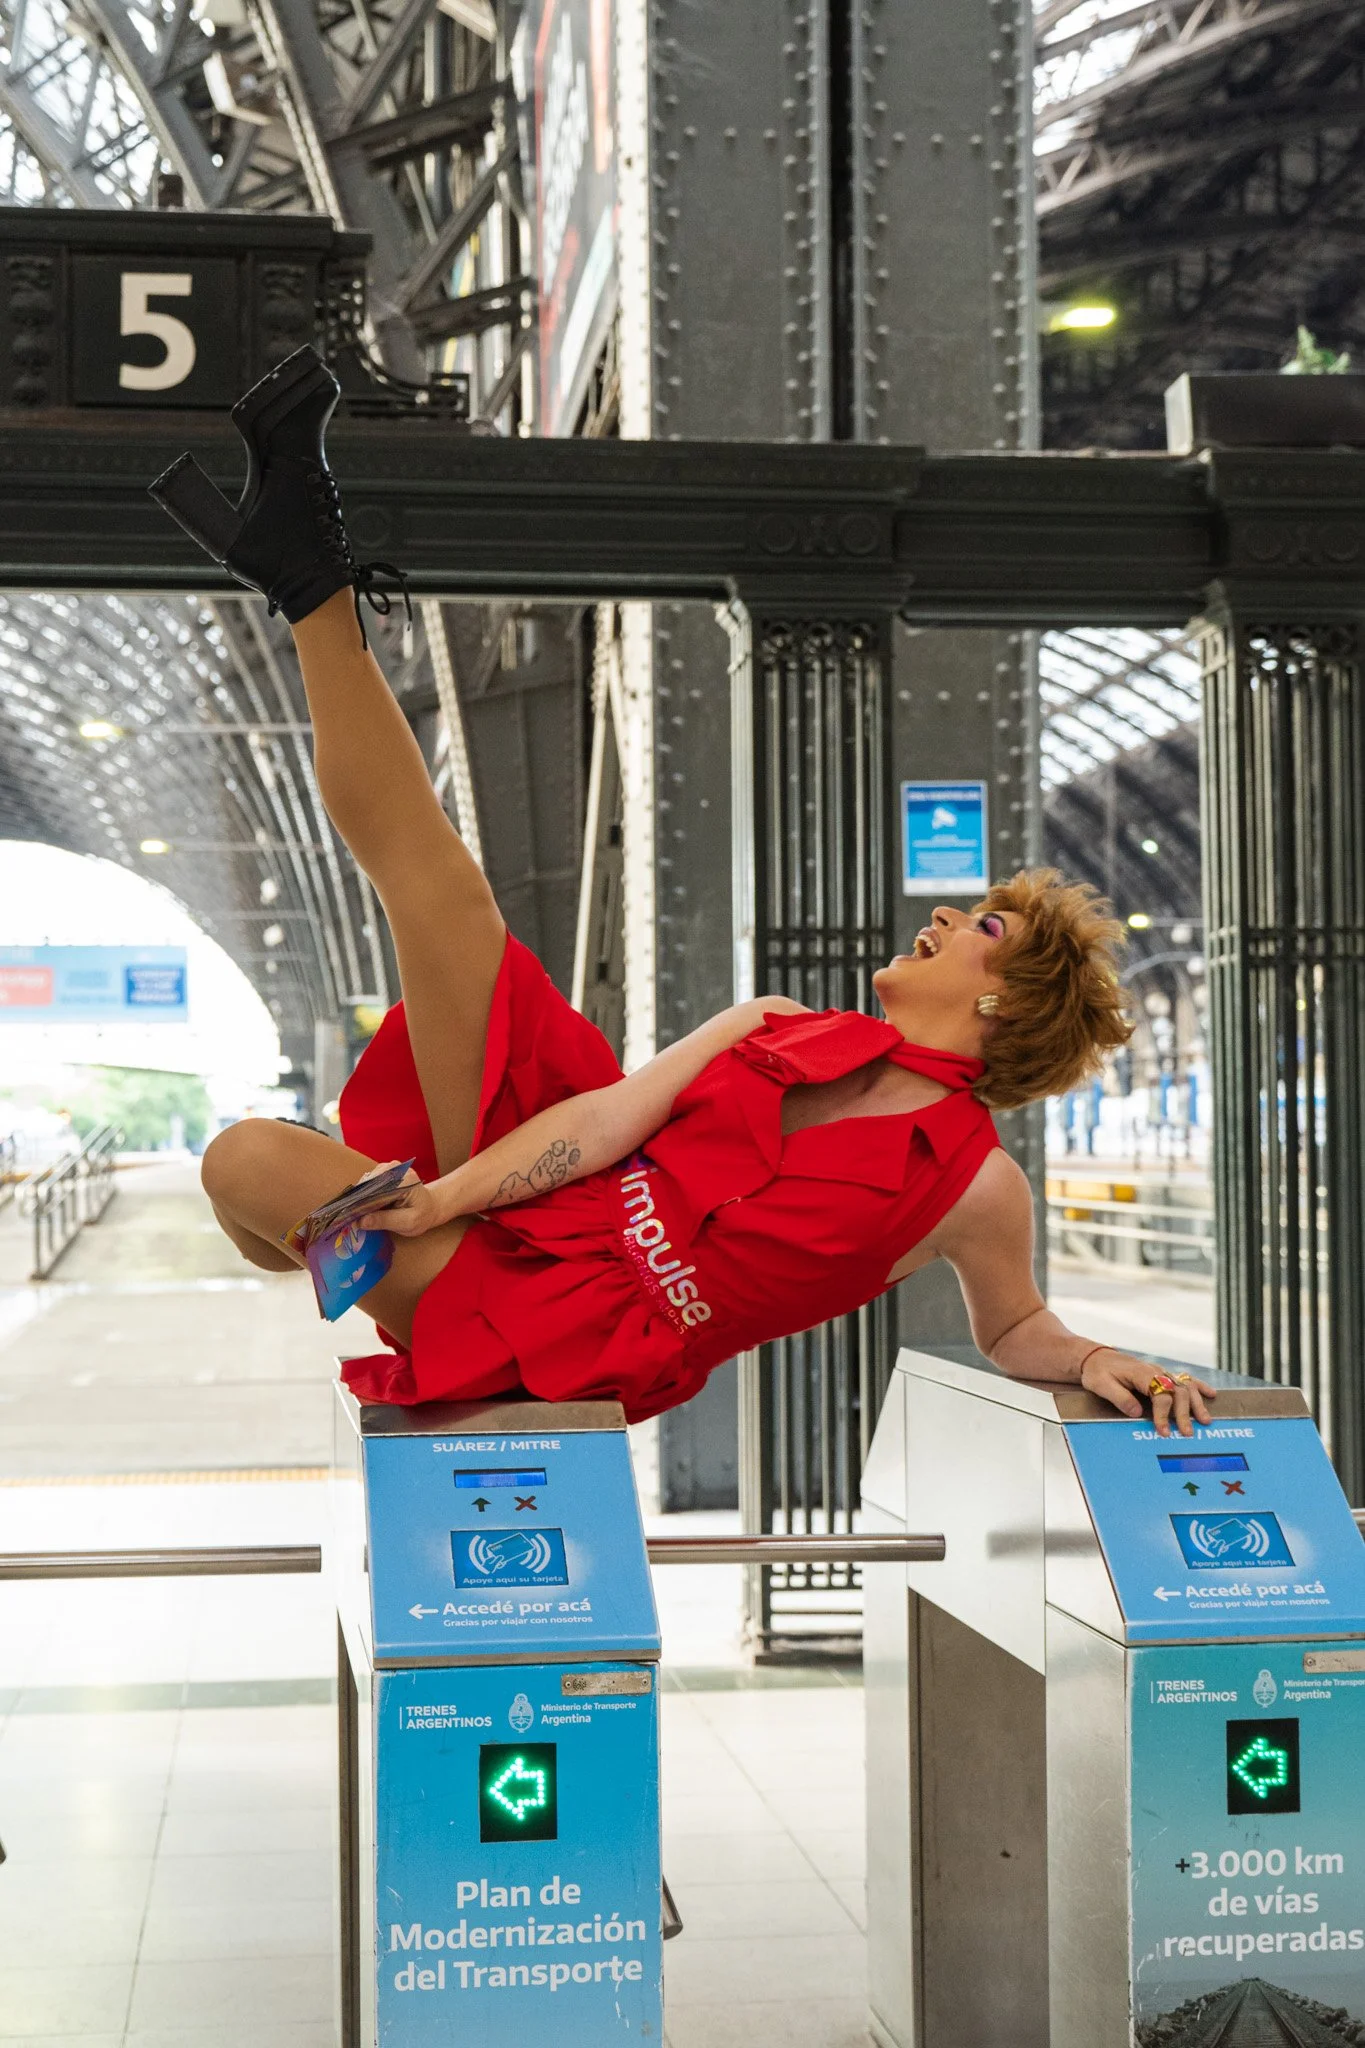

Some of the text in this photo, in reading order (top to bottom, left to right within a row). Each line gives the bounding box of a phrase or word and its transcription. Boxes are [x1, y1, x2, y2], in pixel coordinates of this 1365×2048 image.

[120, 272, 196, 391] 5
[620, 1167, 712, 1327] impulse
[1205, 1428, 1255, 1439] MITRE
[432, 1440, 497, 1453] SUÁREZ
[510, 1440, 561, 1451] MITRE
[463, 1577, 493, 1585] Apoye
[532, 1575, 563, 1584] tarjeta
[1186, 1580, 1326, 1598] Accedé por acá
[443, 1598, 592, 1616] Accedé por acá
[1189, 1600, 1223, 1609] Gracias
[1225, 1601, 1240, 1609] por
[1243, 1598, 1269, 1608] viajar
[1289, 1597, 1330, 1606] nosotros
[443, 1618, 480, 1628] Gracias
[482, 1619, 499, 1628] por
[500, 1616, 527, 1626] viajar
[550, 1615, 593, 1624] nosotros
[1156, 1680, 1205, 1692] TRENES
[1283, 1679, 1321, 1688] Ministerio
[1322, 1678, 1332, 1687] de
[1157, 1691, 1238, 1704] ARGENTINOS
[1283, 1689, 1332, 1702] Argentina
[406, 1705, 457, 1717] TRENES
[541, 1701, 637, 1712] Ministerio de Transporte
[406, 1716, 492, 1730] ARGENTINOS
[541, 1713, 592, 1726] Argentina
[1295, 1846, 1344, 1876] km
[456, 1876, 581, 1909] Plan de
[1208, 1883, 1319, 1918] de vías
[390, 1912, 646, 1953] Modernización
[1164, 1922, 1364, 1962] recuperadas
[394, 1955, 643, 1993] del Transporte
